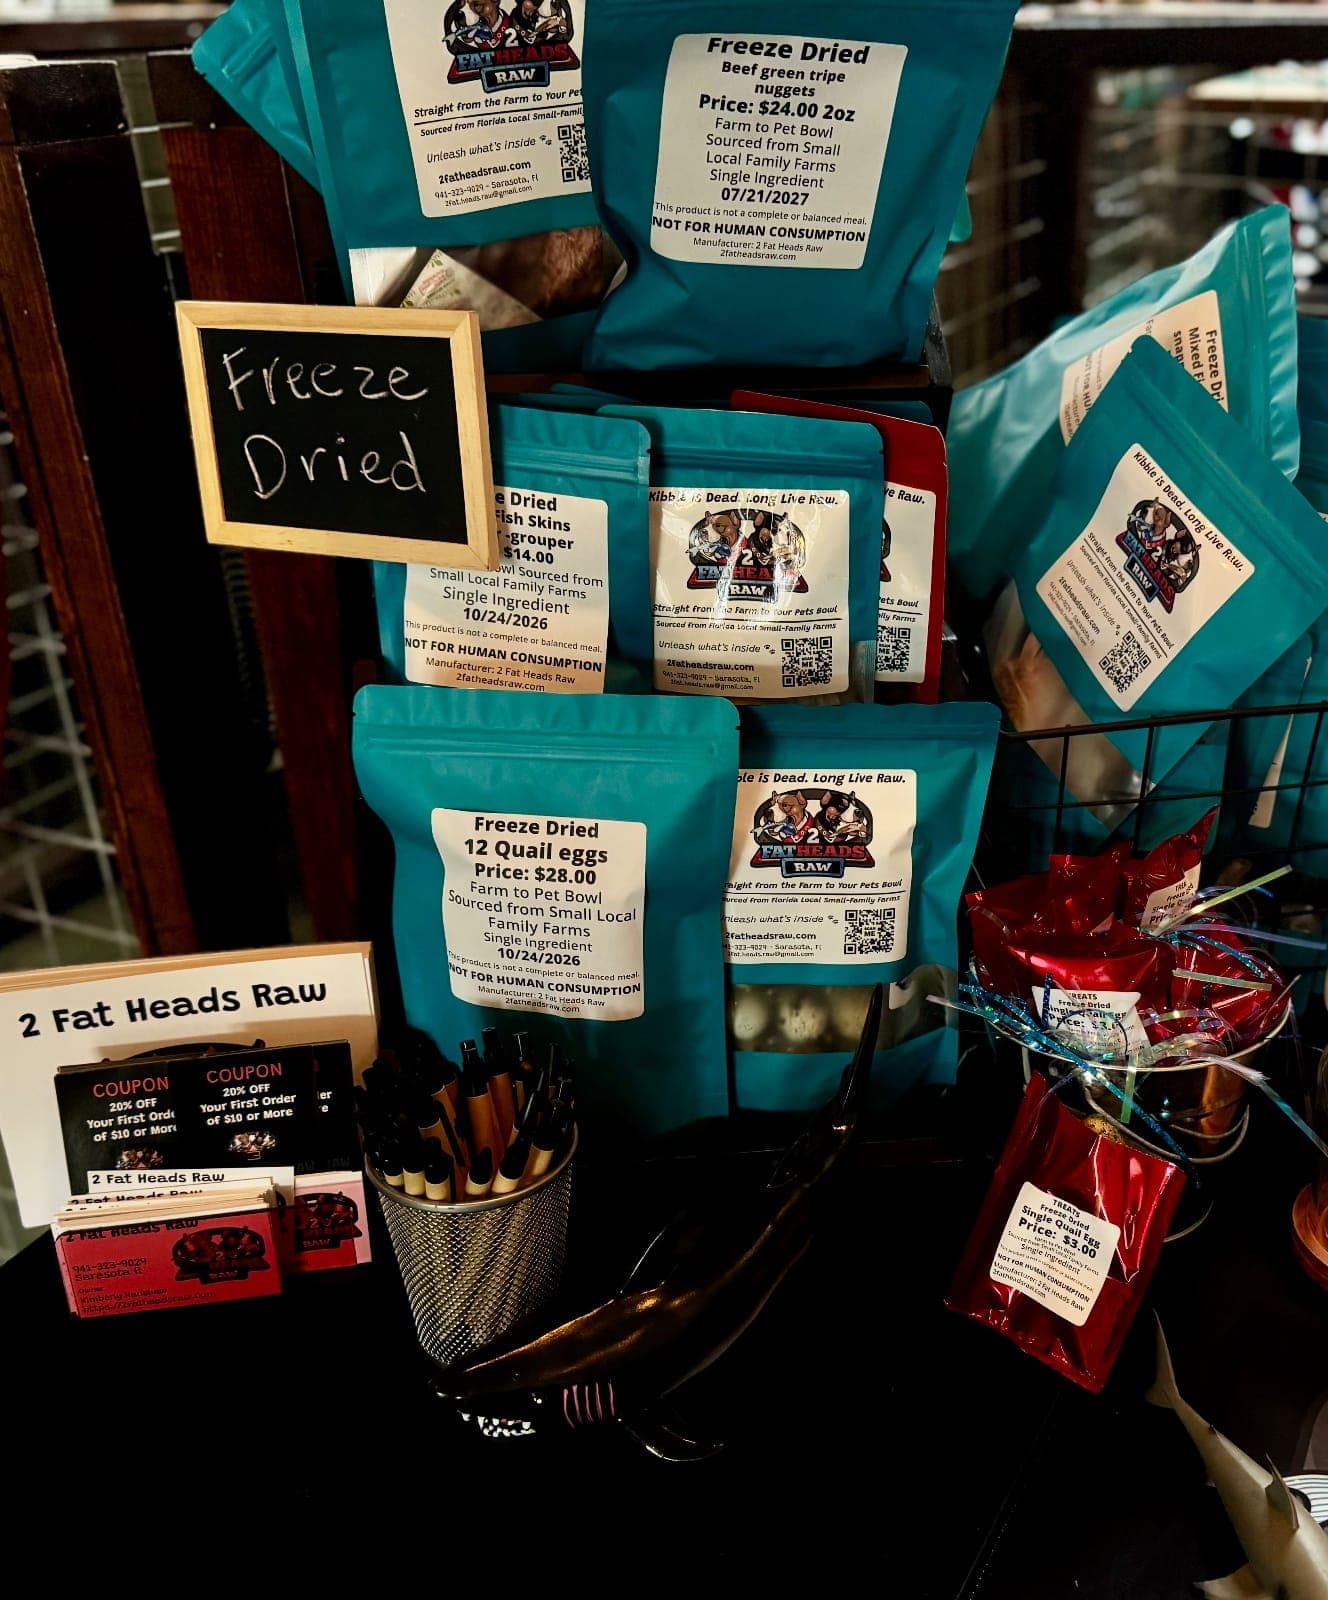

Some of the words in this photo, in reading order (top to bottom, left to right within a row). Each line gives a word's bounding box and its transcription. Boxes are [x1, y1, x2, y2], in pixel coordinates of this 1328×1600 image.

[505, 28, 519, 47] 2
[707, 38, 792, 59] Freeze
[801, 42, 870, 64] Dried
[495, 68, 536, 83] RAW
[722, 62, 759, 75] Beef
[761, 64, 805, 80] green
[810, 70, 846, 85] tripe
[755, 83, 815, 98] nuggets
[414, 104, 454, 118] Straight
[457, 102, 481, 111] from
[485, 98, 500, 107] the
[504, 95, 529, 105] Farm
[532, 92, 542, 101] to
[546, 90, 566, 100] Your
[700, 94, 753, 114] Price:
[759, 101, 818, 118] $24.00
[823, 105, 855, 122] 2oz
[420, 125, 452, 137] Sourced
[455, 122, 474, 131] from
[477, 118, 506, 128] Florida
[508, 114, 530, 123] Local
[715, 118, 750, 133] Farm
[756, 122, 769, 134] to
[774, 123, 796, 135] Pet
[800, 125, 833, 139] Bowl
[427, 147, 466, 163] Unleash
[470, 142, 501, 156] what's
[504, 137, 536, 149] inside
[706, 134, 762, 149] Sourced
[766, 138, 799, 152] from
[803, 143, 840, 156] Small
[439, 160, 532, 184] 2fatheadsraw.com
[706, 151, 741, 165] Local
[746, 154, 790, 172] Family
[795, 159, 836, 173] Farms
[710, 169, 750, 186] Single
[755, 172, 824, 188] Ingredient
[721, 187, 810, 206] 07/21/2027
[655, 203, 673, 213] This
[676, 205, 711, 218] product
[713, 207, 721, 215] is
[723, 208, 737, 217] not
[749, 209, 789, 222] complete
[791, 213, 800, 221] or
[803, 212, 841, 223] balanced
[844, 216, 867, 225] meal.
[652, 216, 682, 230] NOT
[685, 221, 710, 233] FOR
[714, 223, 766, 237] HUMAN
[770, 226, 865, 241] CONSUMPTION
[694, 238, 754, 249] Manufacturer:
[756, 242, 761, 250] 2
[763, 242, 776, 250] Fat
[778, 242, 804, 252] Heads
[720, 249, 796, 261] 2fatheadsraw.com
[1189, 327, 1202, 370] Mixed
[1206, 330, 1220, 380] Freeze
[222, 346, 429, 411] Freeze
[244, 430, 426, 500] Dried
[511, 492, 557, 511] Dried
[897, 492, 926, 504] Raw.
[1133, 451, 1157, 479] Kibble
[1155, 476, 1165, 487] is
[1163, 484, 1184, 511] Dead.
[1184, 508, 1206, 534] Long
[1204, 530, 1224, 551] Live
[528, 515, 571, 532] Skins
[505, 533, 574, 550] -grouper
[503, 547, 554, 564] $14.00
[741, 550, 754, 565] 2
[430, 568, 464, 582] Small
[468, 573, 499, 587] Local
[503, 579, 544, 595] Family
[548, 586, 586, 599] Farms
[1131, 561, 1153, 590] RAW
[443, 587, 488, 605] Single
[493, 593, 569, 614] Ingredient
[728, 584, 766, 596] RAW
[464, 608, 548, 630] 10/24/2026
[795, 607, 815, 616] Pets
[816, 605, 838, 614] Bowl
[405, 638, 428, 649] NOT
[431, 641, 454, 653] FOR
[458, 644, 506, 659] HUMAN
[511, 652, 602, 672] CONSUMPTION
[456, 673, 545, 692] 2fatheadsraw.com
[758, 773, 769, 783] is
[774, 774, 808, 783] Dead.
[813, 774, 844, 786] Long
[849, 773, 873, 783] Live
[877, 774, 906, 783] Raw.
[475, 817, 540, 834] Freeze
[546, 820, 599, 838] Dried
[807, 828, 819, 843] 2
[465, 839, 488, 856] 12
[495, 840, 552, 860] Quail
[559, 848, 608, 866] eggs
[762, 845, 866, 859] FATHEADS
[475, 863, 529, 880] Price:
[535, 866, 596, 884] $28.00
[793, 863, 832, 872] RAW
[470, 881, 509, 897] Farm
[514, 887, 529, 898] to
[535, 888, 559, 901] Pet
[566, 890, 602, 904] Bowl
[781, 881, 795, 889] the
[882, 879, 902, 888] Bowl
[484, 933, 522, 946] Single
[525, 936, 592, 952] Ingredient
[497, 948, 580, 966] 10/24/2026
[471, 971, 493, 983] FOR
[497, 975, 544, 989] HUMAN
[548, 982, 641, 996] CONSUMPTION
[18, 1013, 41, 1038] 2
[52, 1002, 114, 1033] Fat
[126, 988, 241, 1022] Heads
[252, 983, 327, 1008] Raw
[206, 1063, 283, 1084] COUPON
[93, 1077, 169, 1098] COUPON
[223, 1086, 246, 1097] 20%
[249, 1083, 271, 1095] OFF
[109, 1100, 133, 1112] 20%
[135, 1098, 157, 1110] OFF
[199, 1101, 228, 1113] Your
[231, 1096, 259, 1110] First
[262, 1093, 296, 1106] Order
[207, 1116, 221, 1126] of
[224, 1112, 243, 1124] $10
[247, 1111, 260, 1121] or
[263, 1107, 293, 1119] More
[92, 1175, 100, 1184] 2
[107, 1174, 132, 1184] Fat
[138, 1172, 186, 1183] Heads
[193, 1172, 225, 1181] Raw
[1040, 1204, 1067, 1219] Freeze
[1068, 1214, 1090, 1231] Dried
[1053, 1199, 1081, 1218] TREATS
[1018, 1217, 1057, 1239] Price:
[1062, 1235, 1097, 1258] $3.00
[1021, 1205, 1053, 1225] Single
[1055, 1219, 1082, 1238] Quail
[1083, 1233, 1101, 1250] Egg
